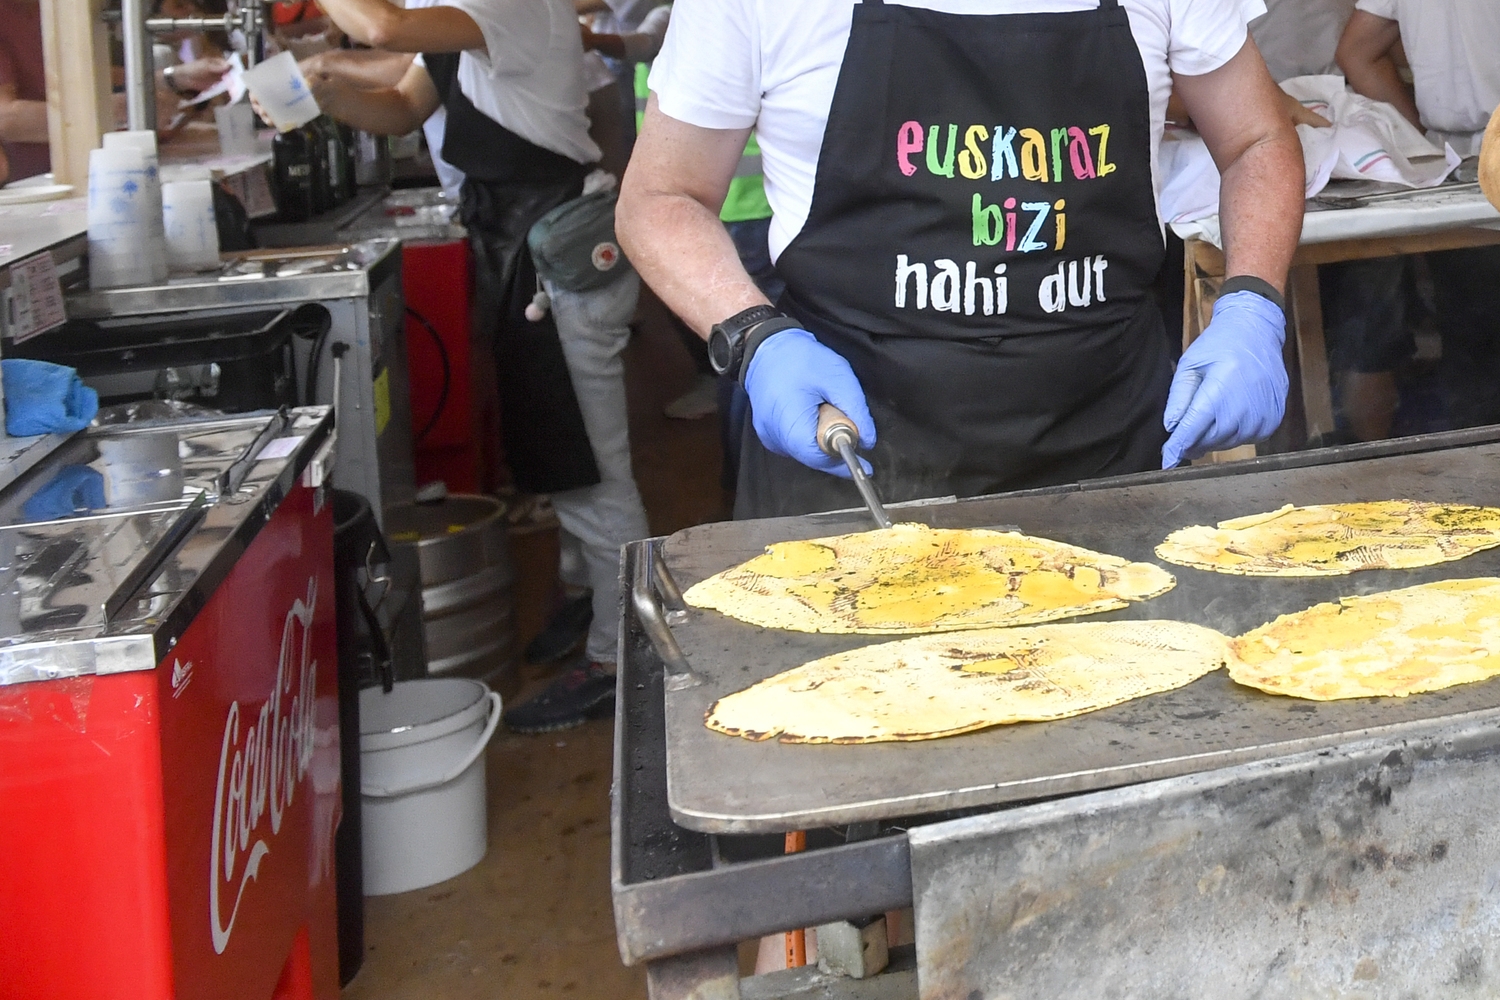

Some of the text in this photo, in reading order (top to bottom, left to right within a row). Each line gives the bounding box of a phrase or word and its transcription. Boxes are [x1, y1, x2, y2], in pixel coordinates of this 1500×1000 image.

[897, 120, 1117, 183] euskaraz
[972, 193, 1066, 253] bizi
[895, 254, 1108, 316] nahi dut
